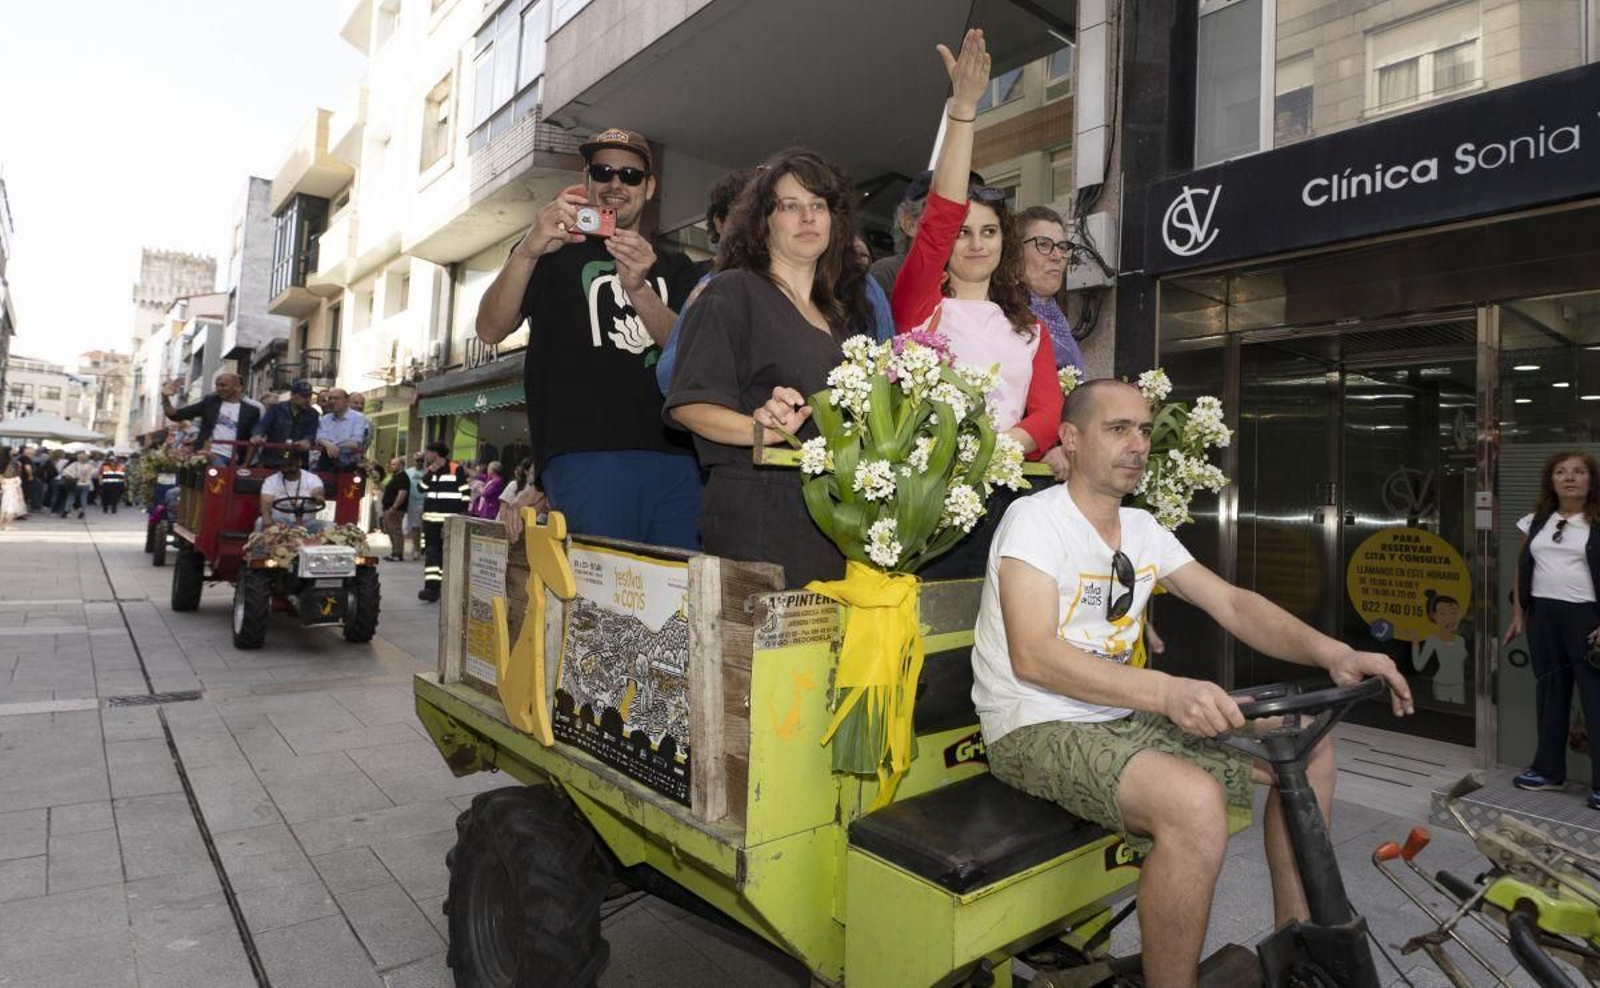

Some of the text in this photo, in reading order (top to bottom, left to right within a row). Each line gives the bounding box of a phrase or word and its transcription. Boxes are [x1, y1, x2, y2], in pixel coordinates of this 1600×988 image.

[1302, 124, 1580, 207] Clínica Sonia
[1393, 534, 1420, 544] PARA
[1381, 543, 1433, 554] RESERVAR
[1364, 552, 1451, 565] CITA Y CONSULTA
[1395, 568, 1405, 577] EN
[1406, 568, 1424, 578] ESTE
[760, 593, 838, 609] APINTER
[1362, 601, 1380, 612] 622
[1384, 602, 1402, 615] 740
[792, 634, 831, 644] REDONDELA
[956, 736, 985, 762] Gri
